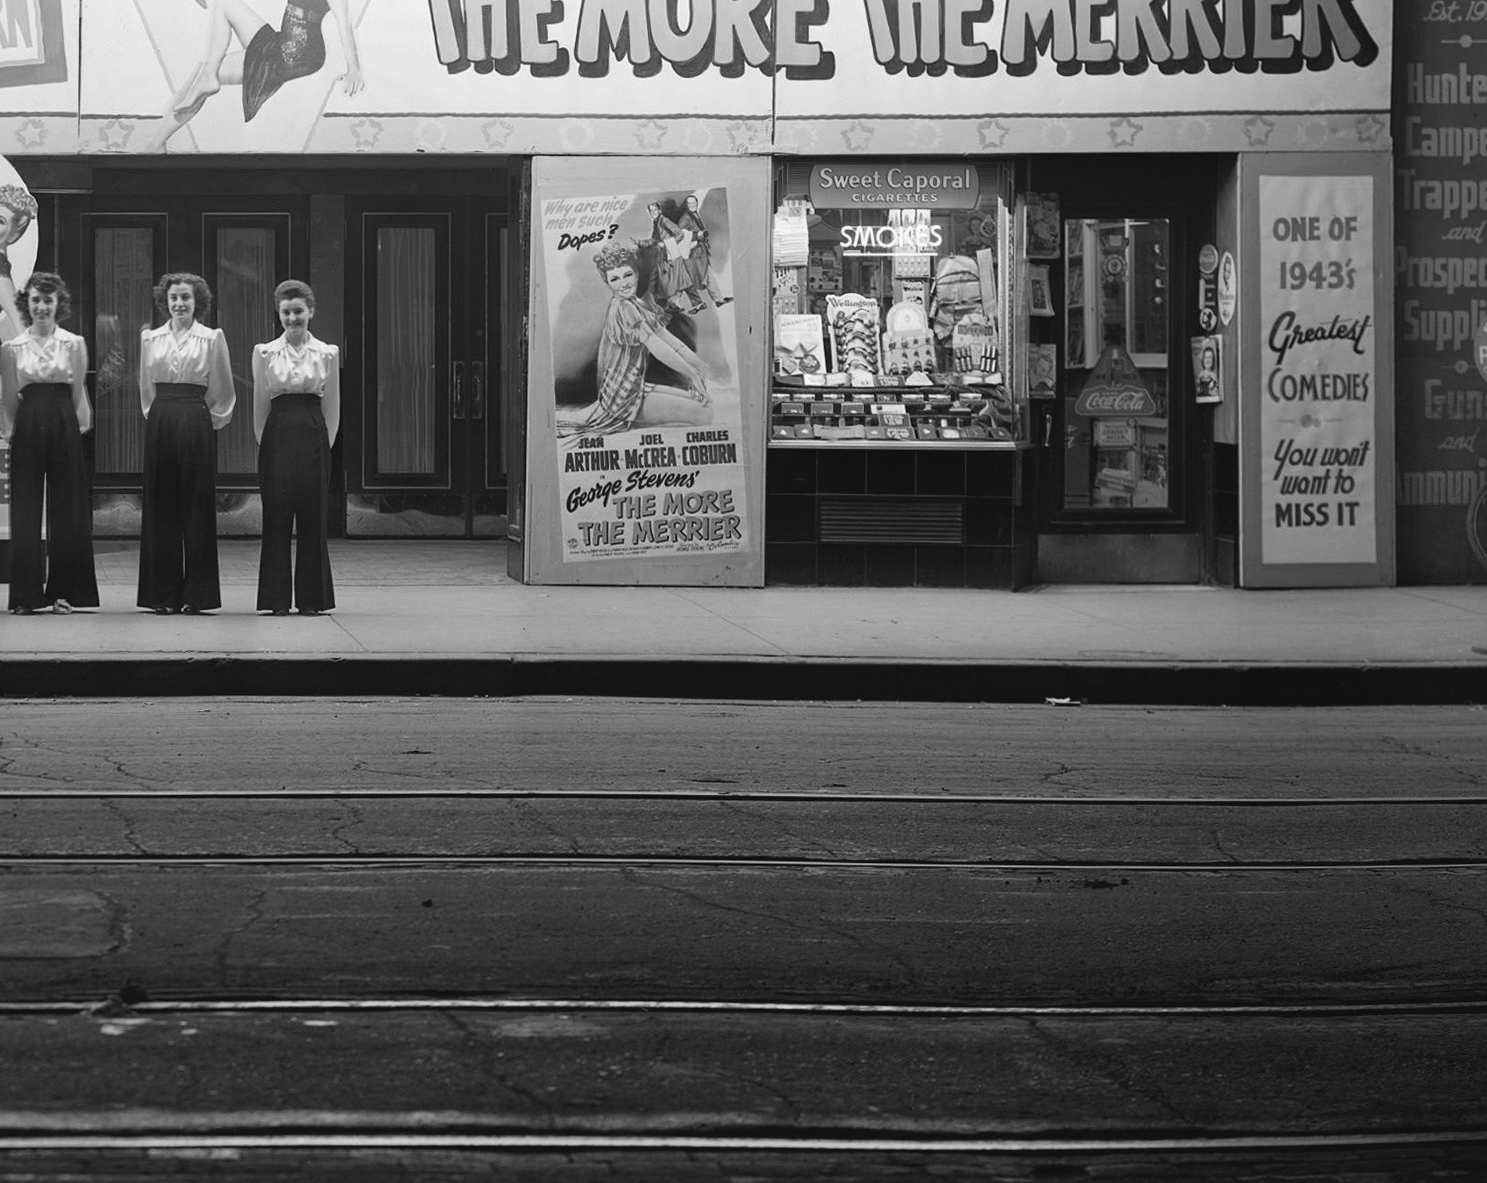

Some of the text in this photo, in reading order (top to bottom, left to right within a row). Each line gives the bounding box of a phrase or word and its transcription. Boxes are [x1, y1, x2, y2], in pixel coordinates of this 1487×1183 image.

[819, 167, 971, 193] Sweet Caporal
[544, 197, 629, 217] Why are nice
[851, 192, 939, 203] CIGARETTES
[545, 217, 575, 231] men
[558, 223, 620, 252] Dopes?
[839, 223, 943, 249] SMOKES
[1272, 215, 1359, 243] ONE OF
[1268, 311, 1372, 366] Greatest
[1268, 367, 1370, 403] COMEDIES
[1085, 390, 1146, 411] Coca-Cola
[578, 429, 729, 449] JEAN JOEL CHARLES
[564, 449, 621, 473] ARTHUR
[681, 443, 737, 466] COBURN
[1274, 438, 1371, 482] You won't
[566, 476, 622, 513] George
[1280, 469, 1356, 496] want to
[612, 489, 736, 520] THE MORE
[1275, 501, 1361, 529] MISS IT
[577, 515, 743, 547] THE MERRIER
